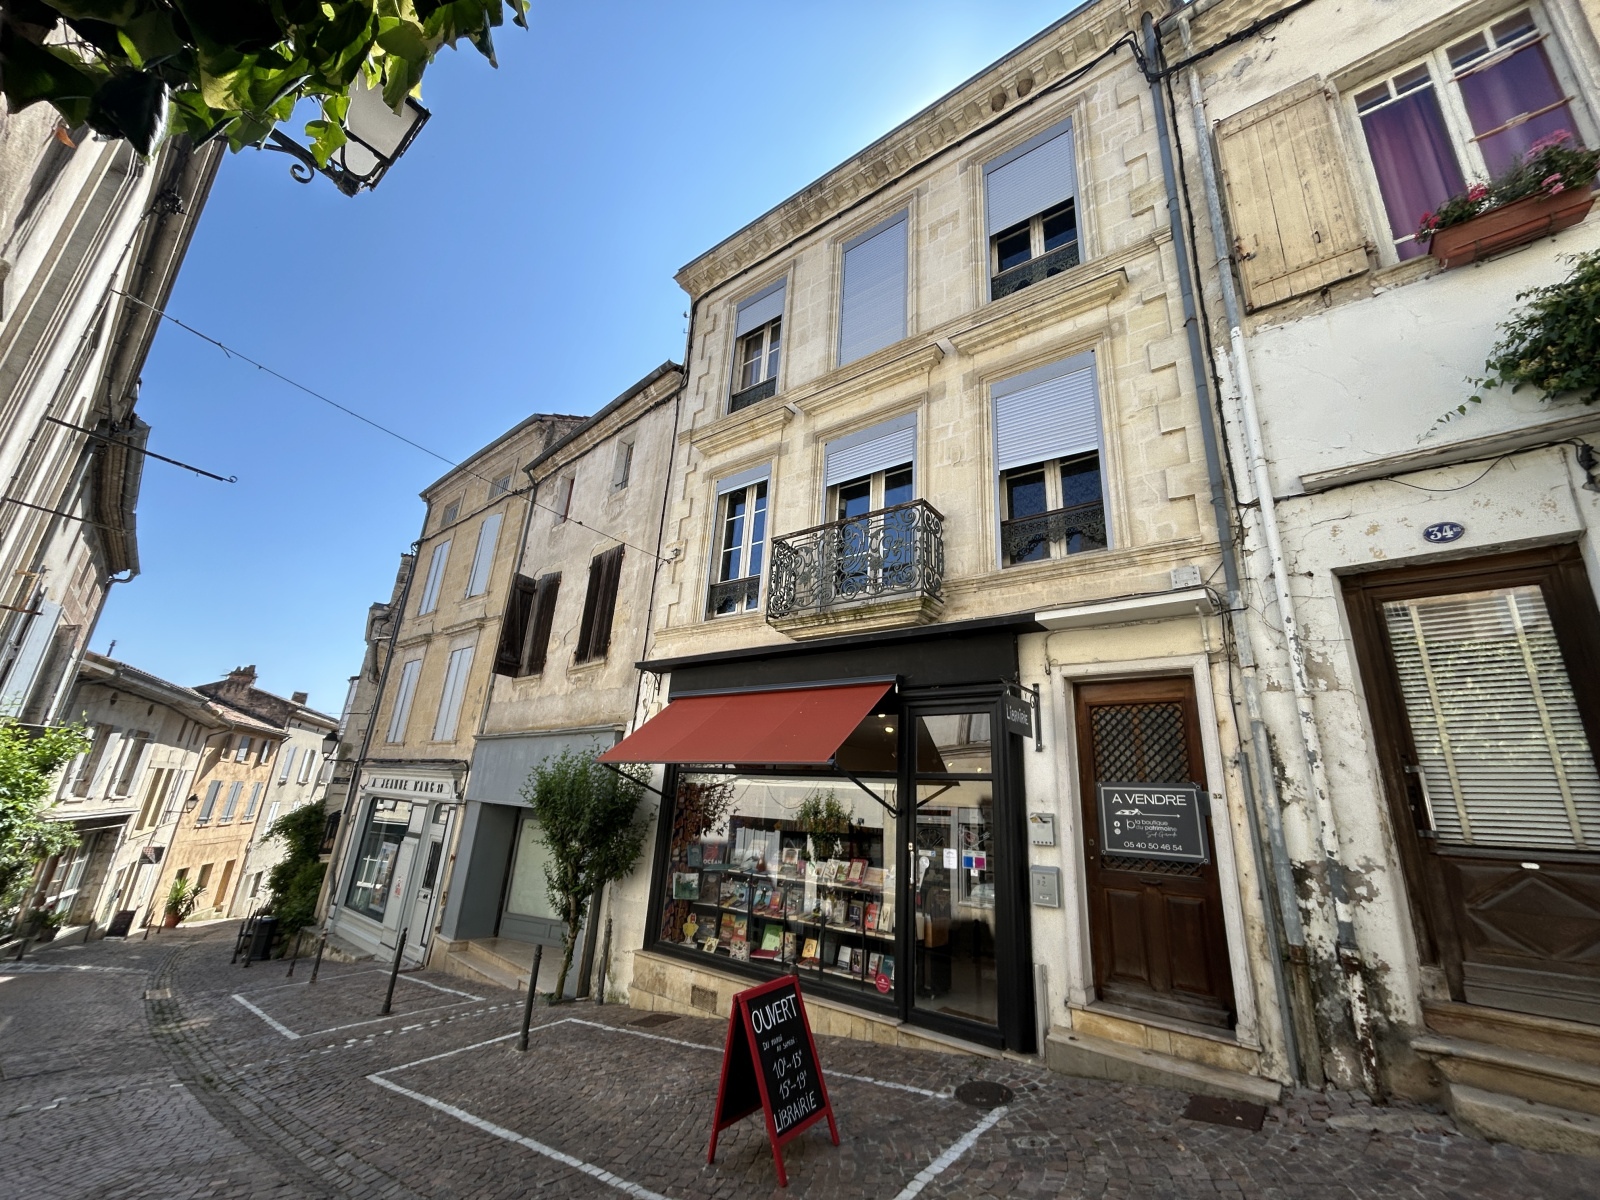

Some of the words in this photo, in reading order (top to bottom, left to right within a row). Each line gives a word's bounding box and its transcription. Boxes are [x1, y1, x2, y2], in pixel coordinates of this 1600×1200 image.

[1429, 525, 1454, 540] 34
[381, 779, 409, 791] JEANNE
[1111, 793, 1123, 804] A
[1124, 793, 1187, 806] VENDRE
[1141, 819, 1169, 827] boutique
[1135, 841, 1147, 849] 40
[1147, 842, 1159, 850] 50
[1172, 844, 1183, 852] 54
[751, 993, 797, 1034] OUVERT
